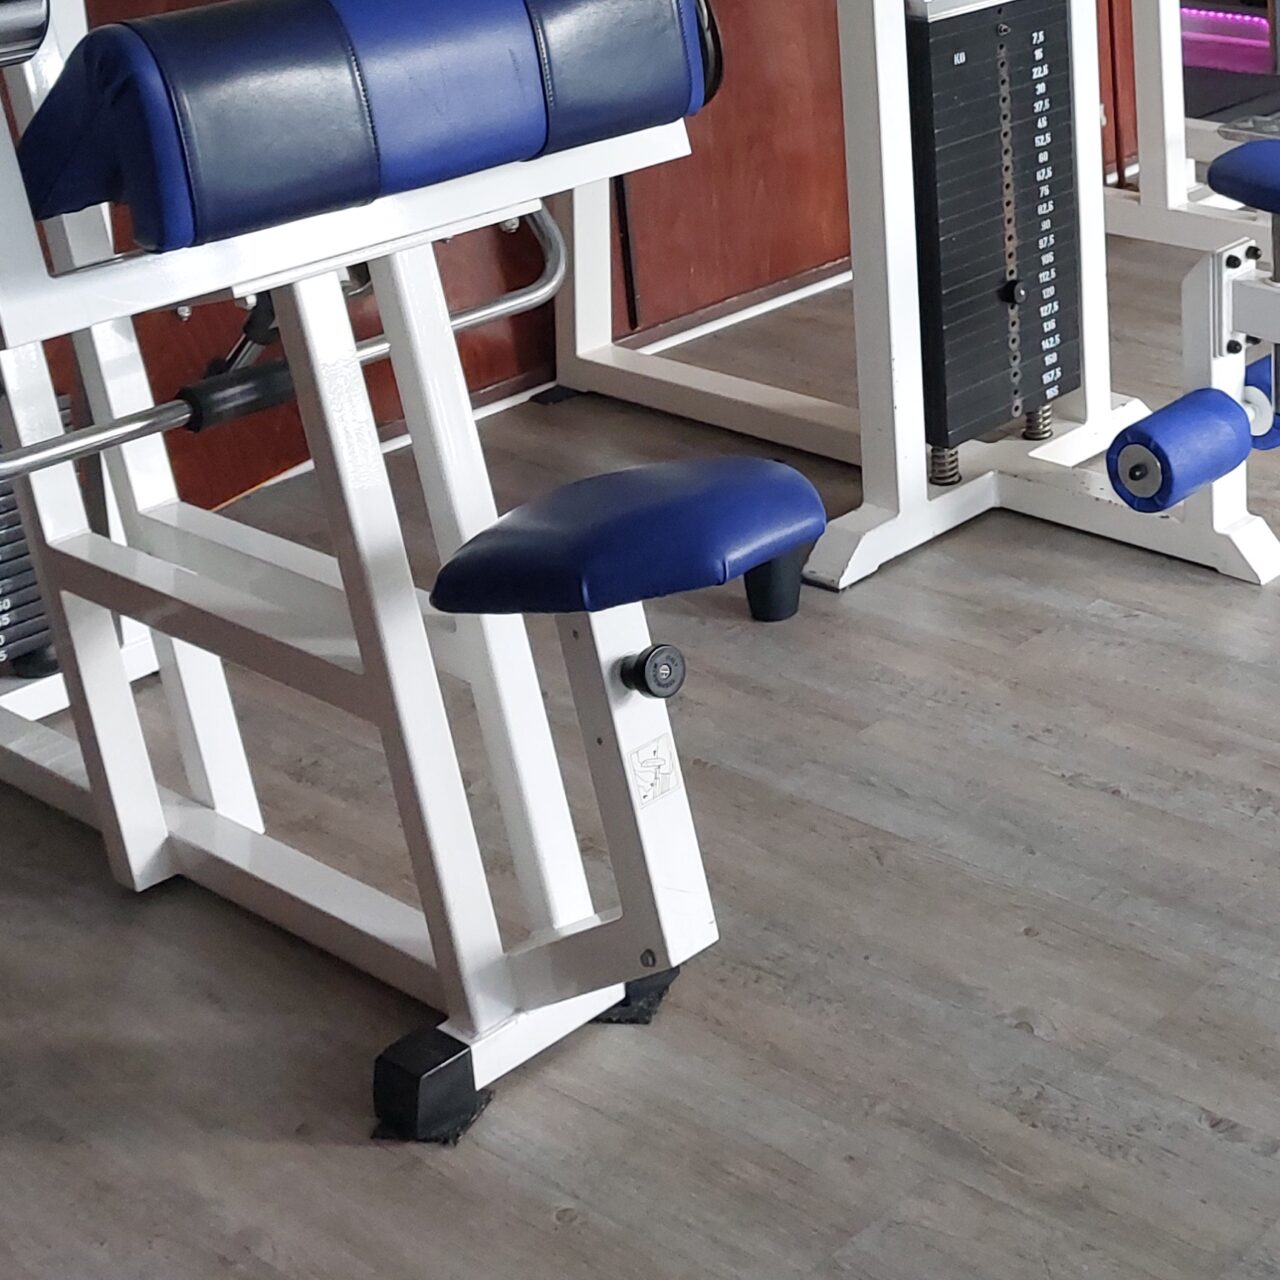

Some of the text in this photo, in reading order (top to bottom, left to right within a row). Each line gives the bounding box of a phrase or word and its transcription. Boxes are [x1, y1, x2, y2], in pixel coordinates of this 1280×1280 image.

[1035, 82, 1046, 96] 30
[1037, 116, 1048, 129] 45
[1039, 184, 1050, 198] 75
